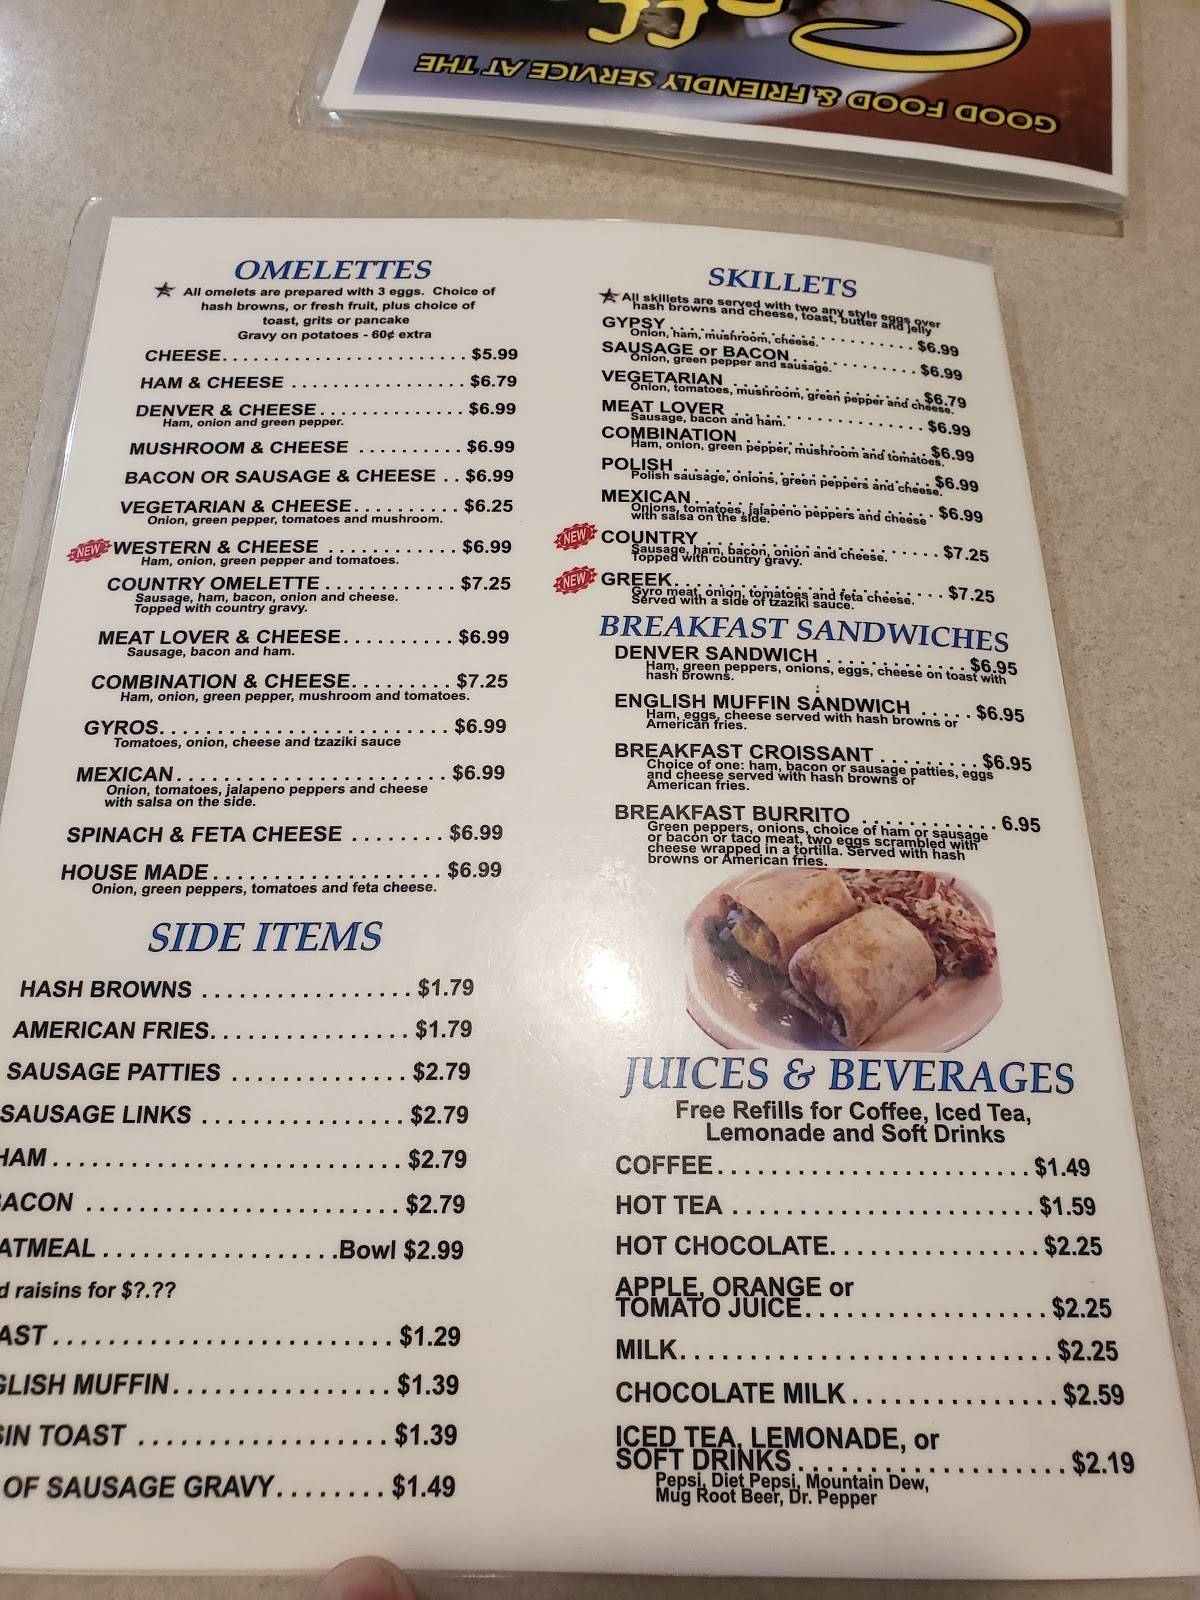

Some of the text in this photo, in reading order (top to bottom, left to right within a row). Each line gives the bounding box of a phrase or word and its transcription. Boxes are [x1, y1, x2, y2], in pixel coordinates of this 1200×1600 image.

[415, 53, 1059, 135] GOOD FOOD & FRIENDLY SERVICE AT THE
[235, 260, 432, 280] OMELETTES
[183, 288, 201, 296] All
[205, 288, 256, 296] omelets
[285, 288, 343, 298] prepared
[347, 287, 373, 296] with
[378, 287, 385, 295] 3
[390, 289, 424, 297] eggs.
[433, 287, 478, 295] Choice
[483, 287, 496, 295] of
[709, 268, 856, 298] SKILLETS
[201, 302, 232, 310] hash
[237, 302, 288, 312] browns,
[311, 302, 343, 310] fresh
[348, 301, 377, 311] fruit,
[383, 301, 410, 312] plus
[415, 301, 457, 309] choice
[462, 301, 475, 309] of
[263, 317, 298, 326] toast,
[303, 316, 332, 327] grits
[355, 315, 409, 326] pancake
[238, 331, 277, 342] Gravy
[302, 331, 358, 341] potatoes
[399, 330, 431, 338] extra
[603, 317, 959, 356] GYPSY $6.99
[631, 328, 819, 346] Onion, ham, mushroom, cheese.
[146, 348, 517, 361] CHEESE $5.99
[141, 375, 517, 389] HAM & CHEESE $6.79
[602, 370, 966, 408] VEGETARIAN $6.79
[136, 402, 516, 416] DENVER & CHEESE $6.99
[603, 400, 970, 437] MEAT LOVER $6.99
[163, 418, 342, 428] Ham, onion and green pepper.
[76, 539, 511, 558] NEW WESTERN & CHEESE $6.99
[562, 528, 989, 562] NEW COUNTRY $7.25
[108, 576, 510, 591] COUNTRY OMELETTE $7.25
[562, 571, 994, 603] NEW GREEK $7.25
[98, 629, 509, 645] MEAT LOVER & CHEESE $6.99
[599, 616, 1008, 652] BREAKFAST SANDWICHES
[127, 646, 294, 659] Sausage, bacon and ham.
[616, 646, 1017, 676] DENVER SANDWICH $6.95
[616, 694, 1024, 722] ENGLISH MUFFIN SANDWICH $6.95
[85, 718, 506, 735] GYROS $6.99
[114, 738, 181, 749] Tomatoes,
[186, 737, 227, 749] onion,
[233, 737, 280, 747] cheese
[285, 737, 310, 746] and
[314, 736, 356, 746] tzaziki
[616, 805, 1040, 832] BREAKFAST BURRITO 6.95
[148, 921, 383, 952] SIDE ITEMS
[20, 978, 474, 998] HASH BROWNS $1.79
[12, 1019, 472, 1040] AMERICAN FRIES $1.79
[7, 1061, 470, 1083] SAUSAGE PATTIES $2.79
[619, 1057, 1074, 1098] JUICES & BEVERAGES
[677, 1100, 1030, 1125] Free Refills for Coffee, Iced Tea,
[707, 1123, 1005, 1143] Lemonade and Soft Drinks
[616, 1155, 1090, 1178] COFFEE $1.49
[617, 1195, 1095, 1218] HOT TEA $1.59
[617, 1235, 1102, 1258] HOT CHOCOLATE $2.25
[15, 1281, 81, 1298] raisins
[88, 1281, 116, 1298] for
[122, 1280, 176, 1300] $?.??
[617, 1338, 1118, 1363] MILK $2.25
[4, 1474, 455, 1500] OF SAUSAGE GRAVY $1.49
[656, 1472, 928, 1493] Pepsi, Diet Pepsi, Mountain Dew,
